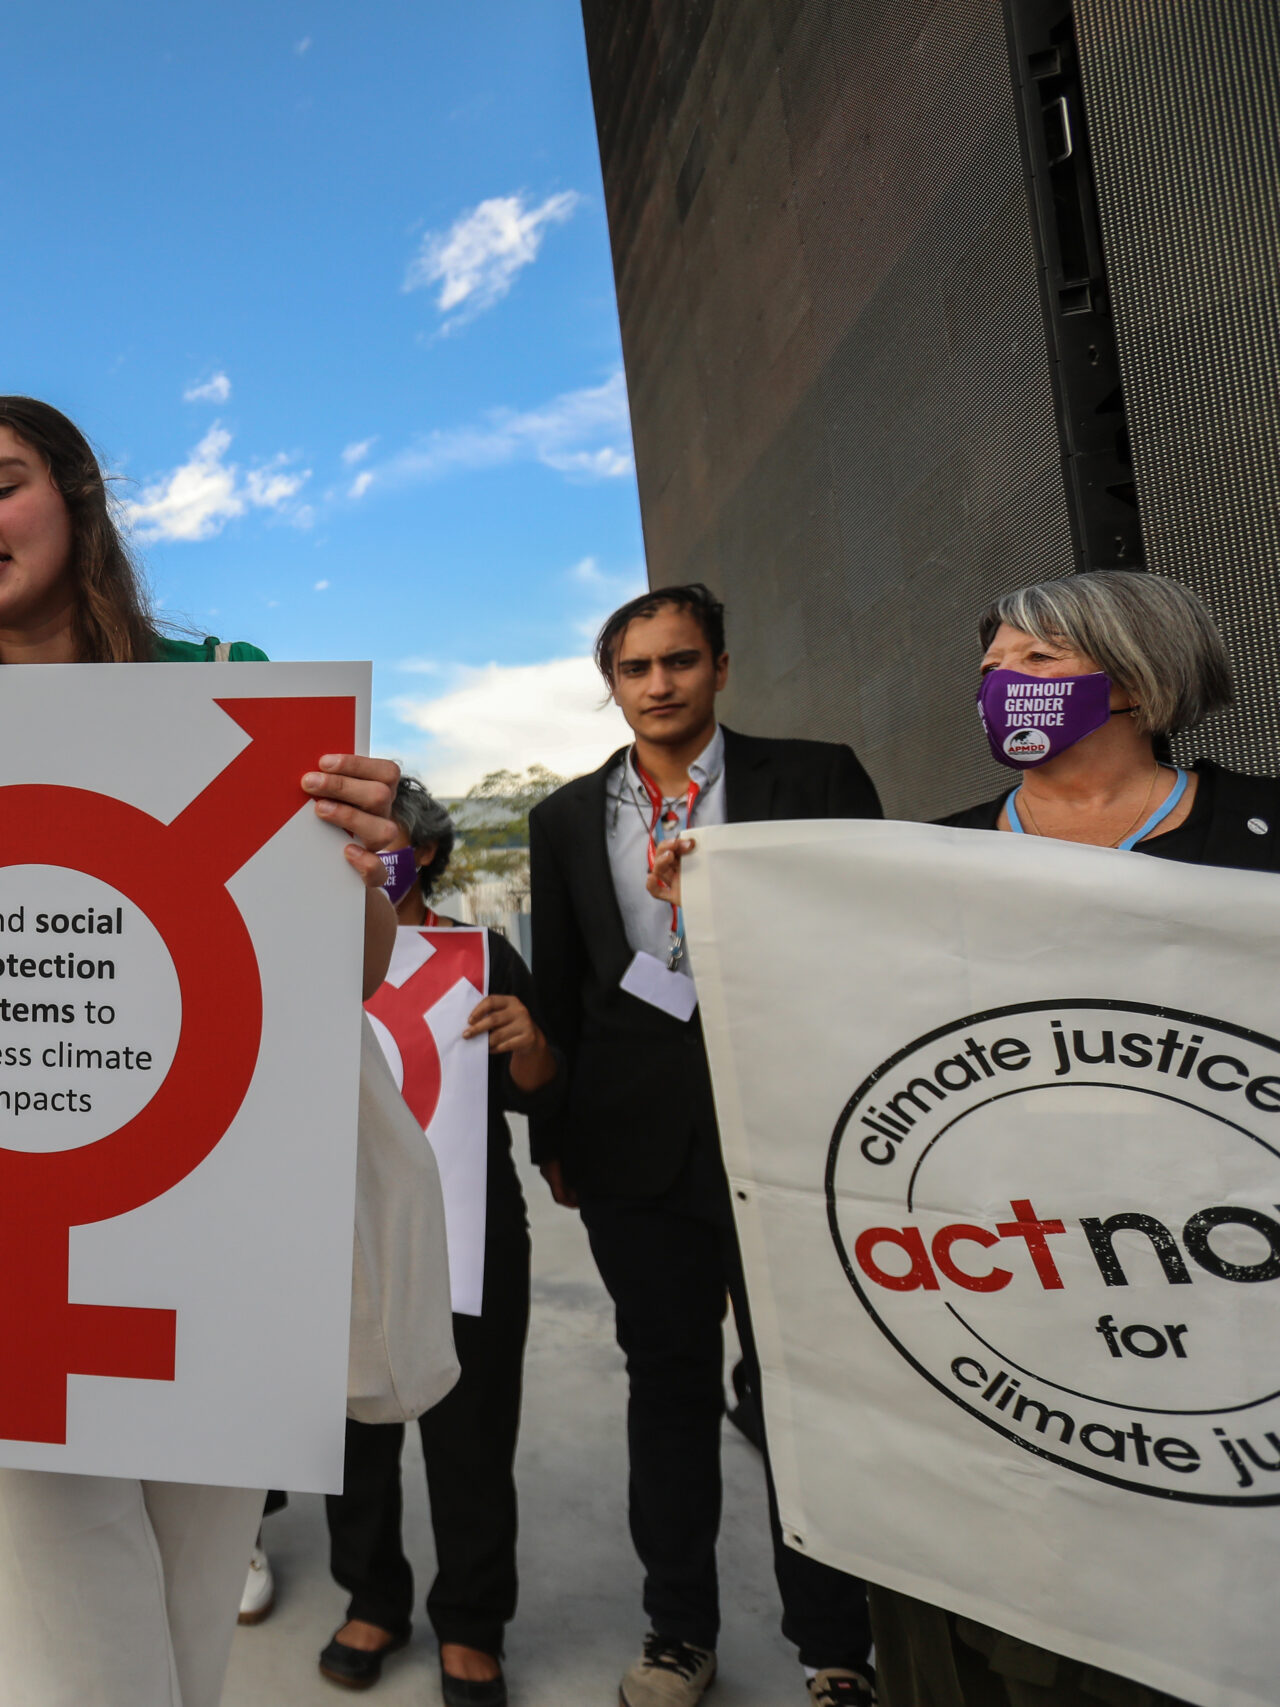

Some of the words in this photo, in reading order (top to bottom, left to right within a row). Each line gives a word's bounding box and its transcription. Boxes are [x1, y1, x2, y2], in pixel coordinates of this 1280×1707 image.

[1007, 682, 1074, 697] WITHOUT
[1005, 698, 1064, 712] GENDER
[1005, 713, 1064, 727] JUSTICE
[1008, 744, 1045, 752] APMDD
[35, 907, 123, 934] social
[84, 1001, 116, 1025] to
[42, 1041, 152, 1070] climate
[860, 1037, 1031, 1166] climate
[1050, 1021, 1280, 1113] justice
[854, 1199, 1066, 1292] act
[1078, 1203, 1280, 1287] no
[1095, 1315, 1188, 1359] for
[951, 1356, 1201, 1473] climate
